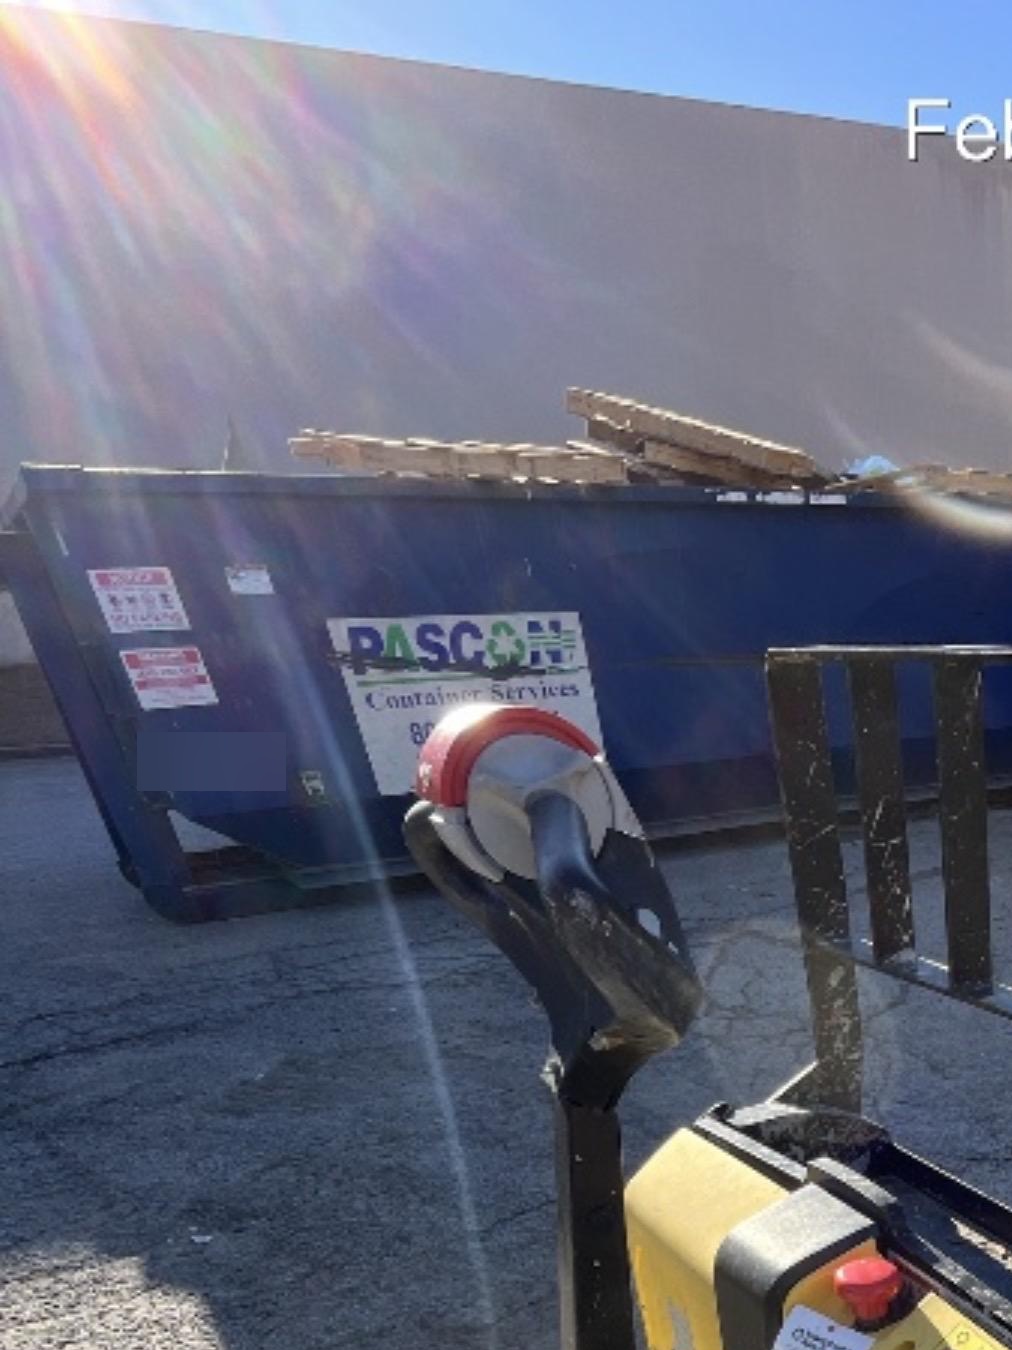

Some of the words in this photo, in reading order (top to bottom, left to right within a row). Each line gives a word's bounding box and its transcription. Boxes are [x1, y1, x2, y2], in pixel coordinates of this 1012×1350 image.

[346, 619, 575, 676] PASCON
[364, 686, 482, 712] Container
[488, 680, 581, 702] Services
